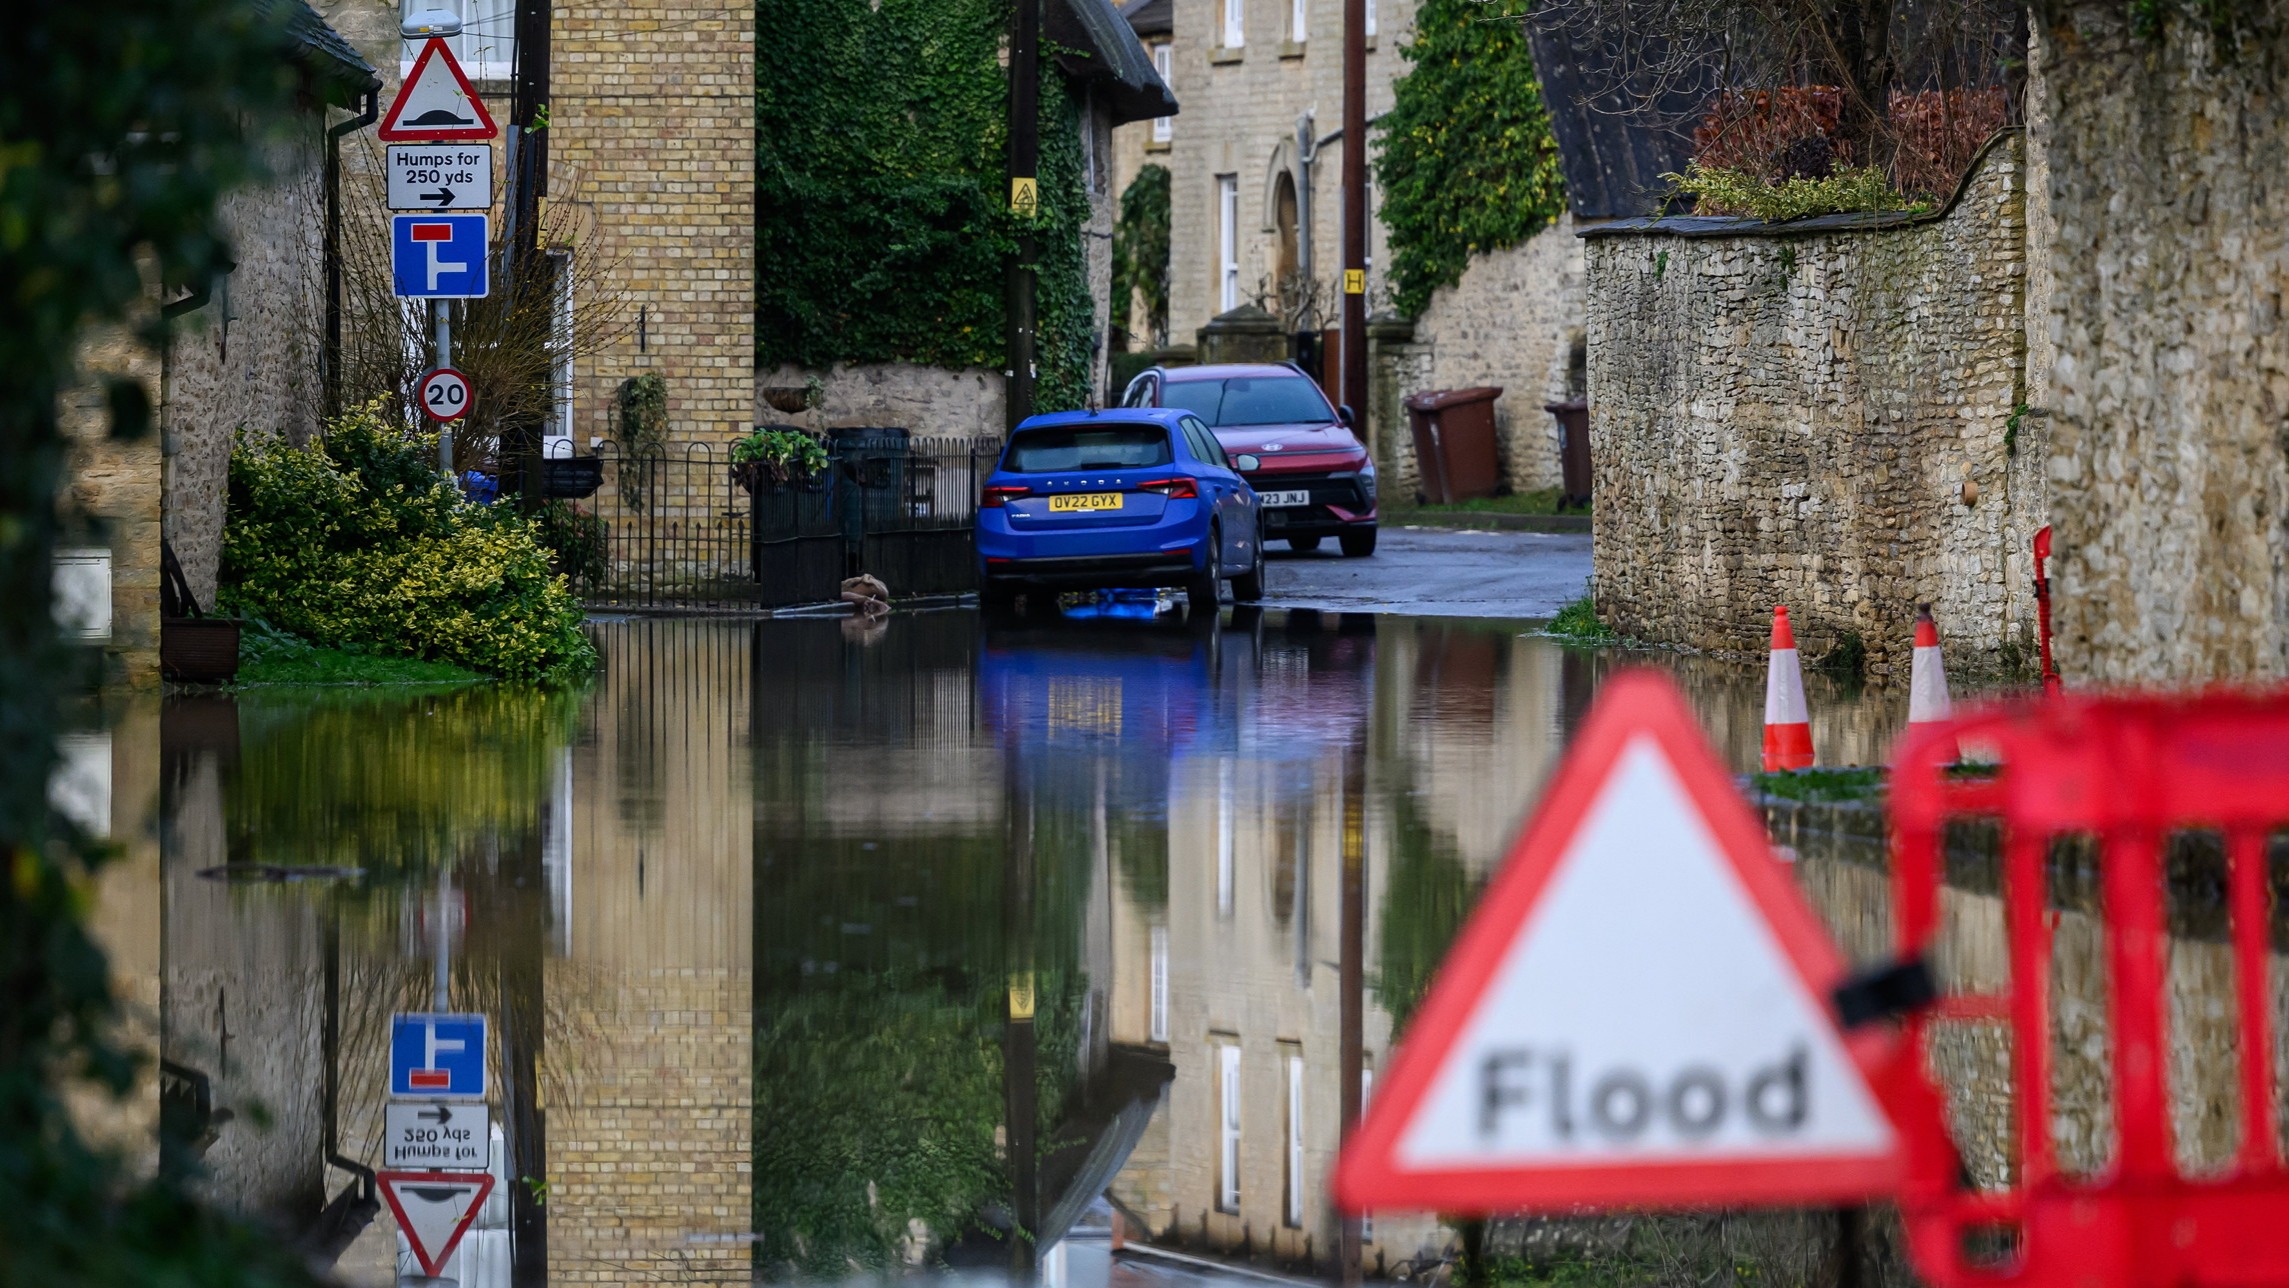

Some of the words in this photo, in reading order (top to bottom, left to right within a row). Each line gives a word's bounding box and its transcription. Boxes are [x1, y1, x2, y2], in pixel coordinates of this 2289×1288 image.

[396, 152, 453, 168] Humps
[457, 152, 480, 165] for
[406, 169, 440, 184] 250
[445, 169, 473, 186] yds
[1347, 273, 1362, 290] H
[428, 383, 464, 405] 20
[1054, 495, 1088, 509] OV22
[1091, 494, 1117, 507] GYX
[1283, 492, 1305, 504] JNJ
[1477, 1038, 1811, 1140] Flood
